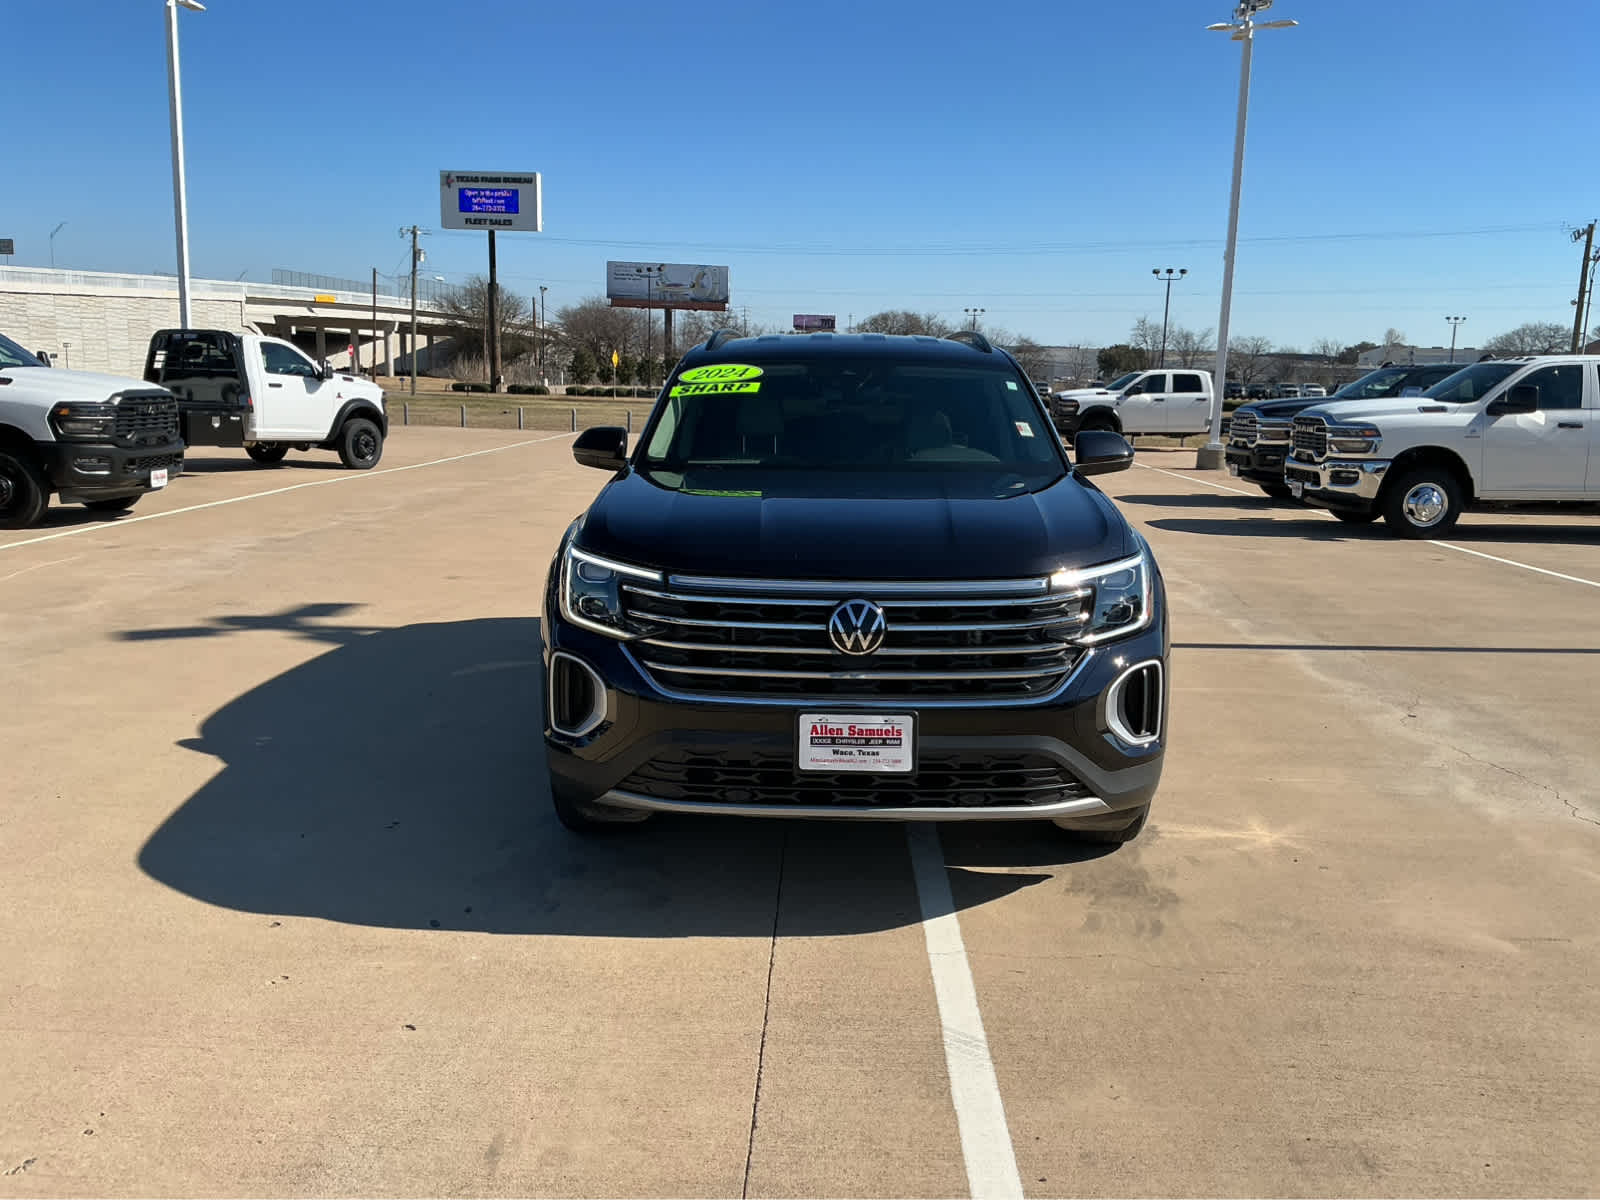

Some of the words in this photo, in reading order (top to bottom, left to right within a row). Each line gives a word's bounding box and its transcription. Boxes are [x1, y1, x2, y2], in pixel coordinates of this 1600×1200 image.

[678, 383, 751, 394] SHARP
[810, 724, 844, 736] Allen
[847, 725, 903, 737] Samuels
[832, 748, 855, 756] Waco,
